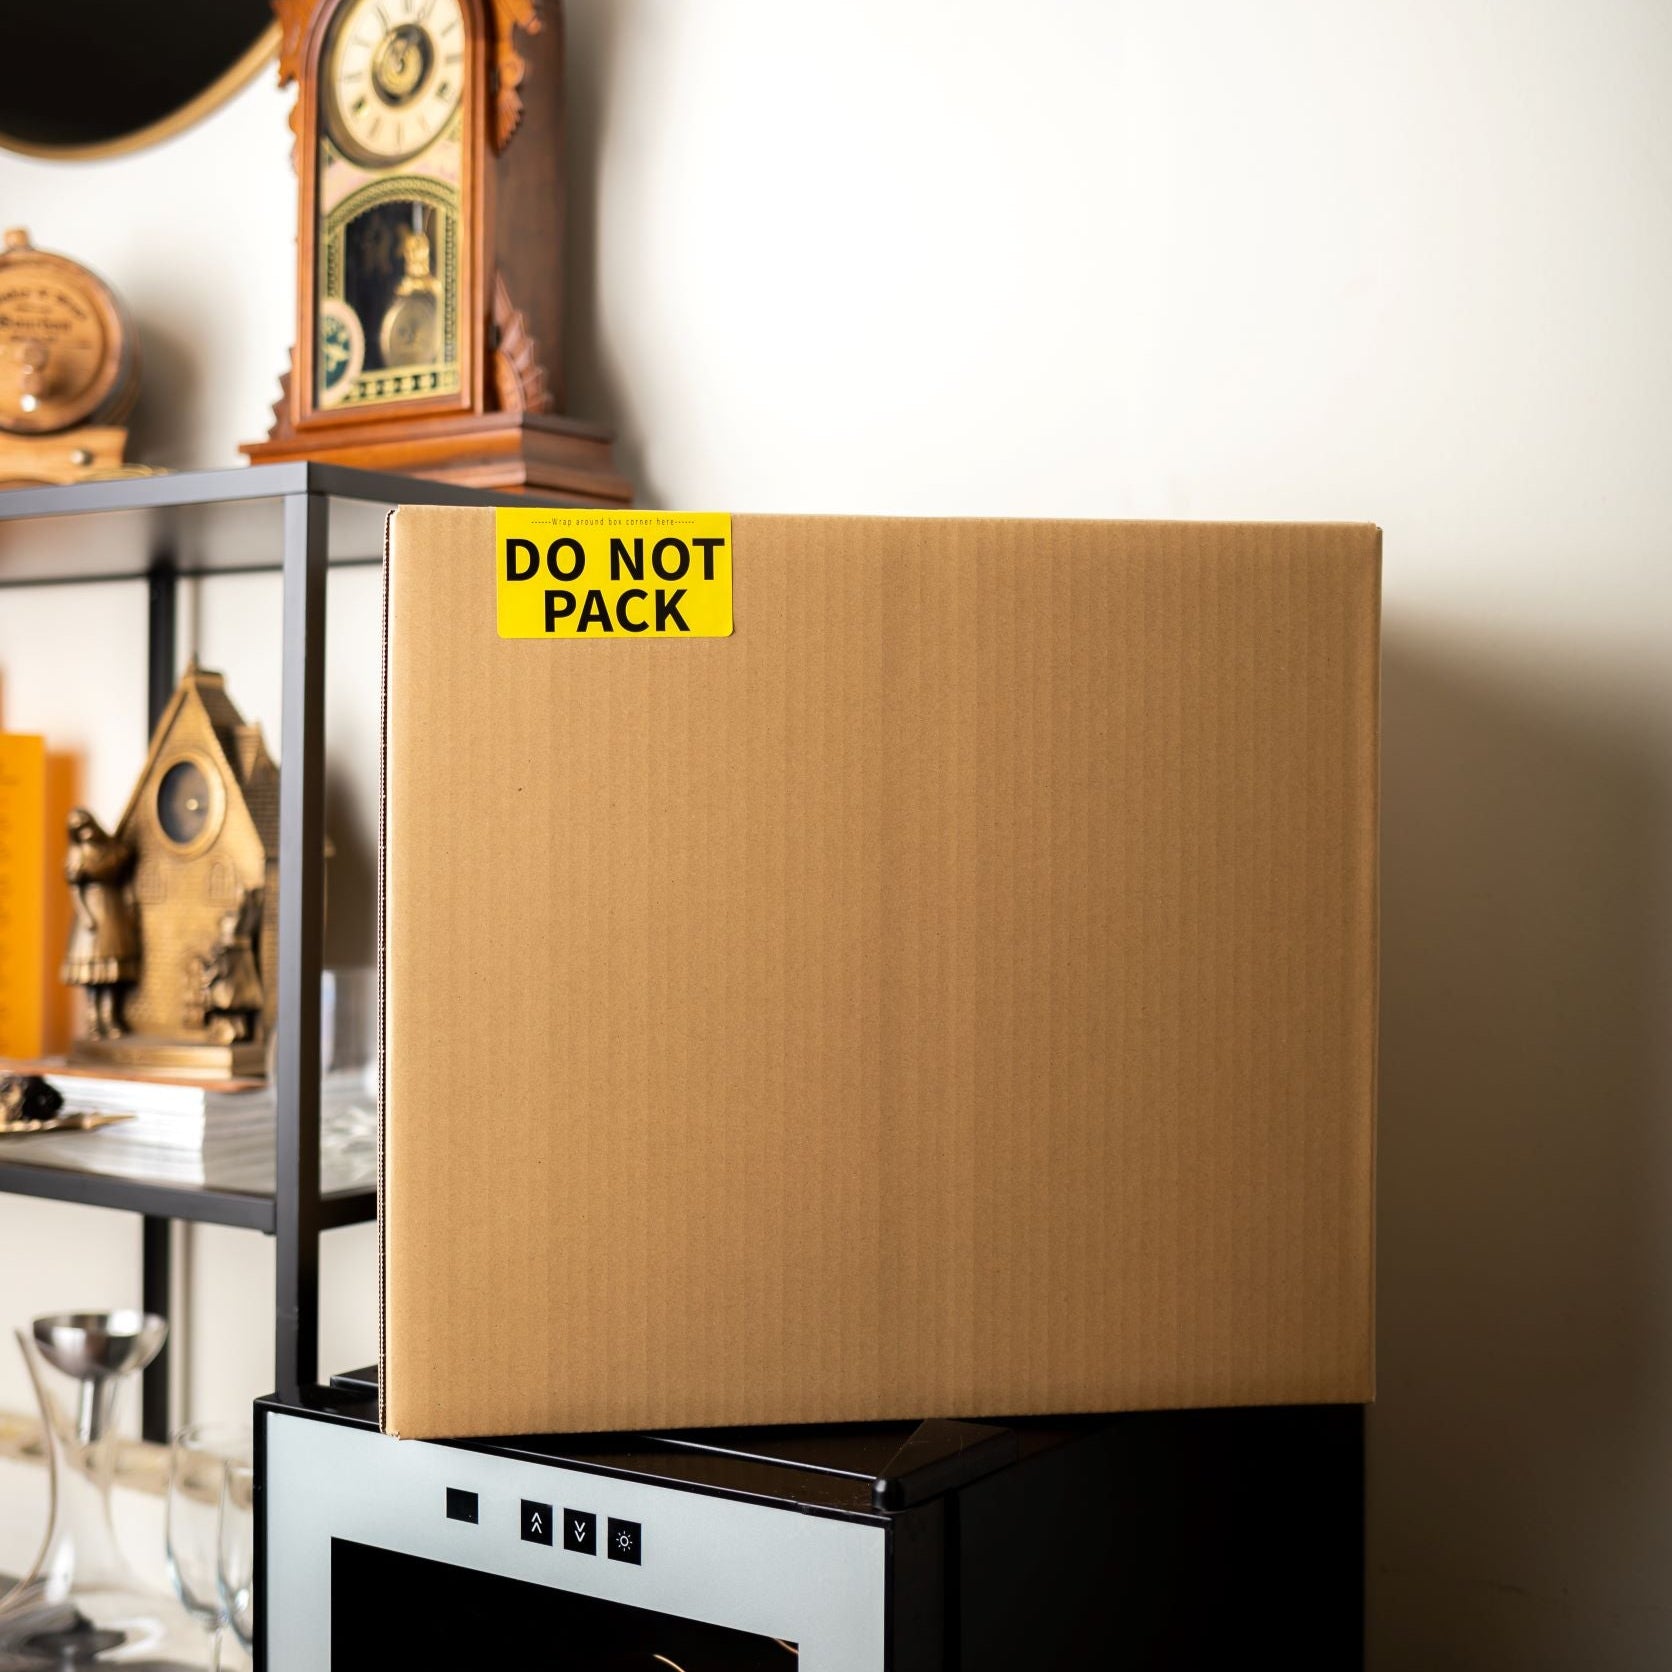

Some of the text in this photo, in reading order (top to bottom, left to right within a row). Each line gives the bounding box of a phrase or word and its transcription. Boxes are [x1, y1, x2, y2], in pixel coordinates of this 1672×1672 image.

[575, 516, 604, 526] around
[608, 517, 622, 526] box
[506, 537, 725, 582] DO NOT
[544, 588, 691, 633] PACK
